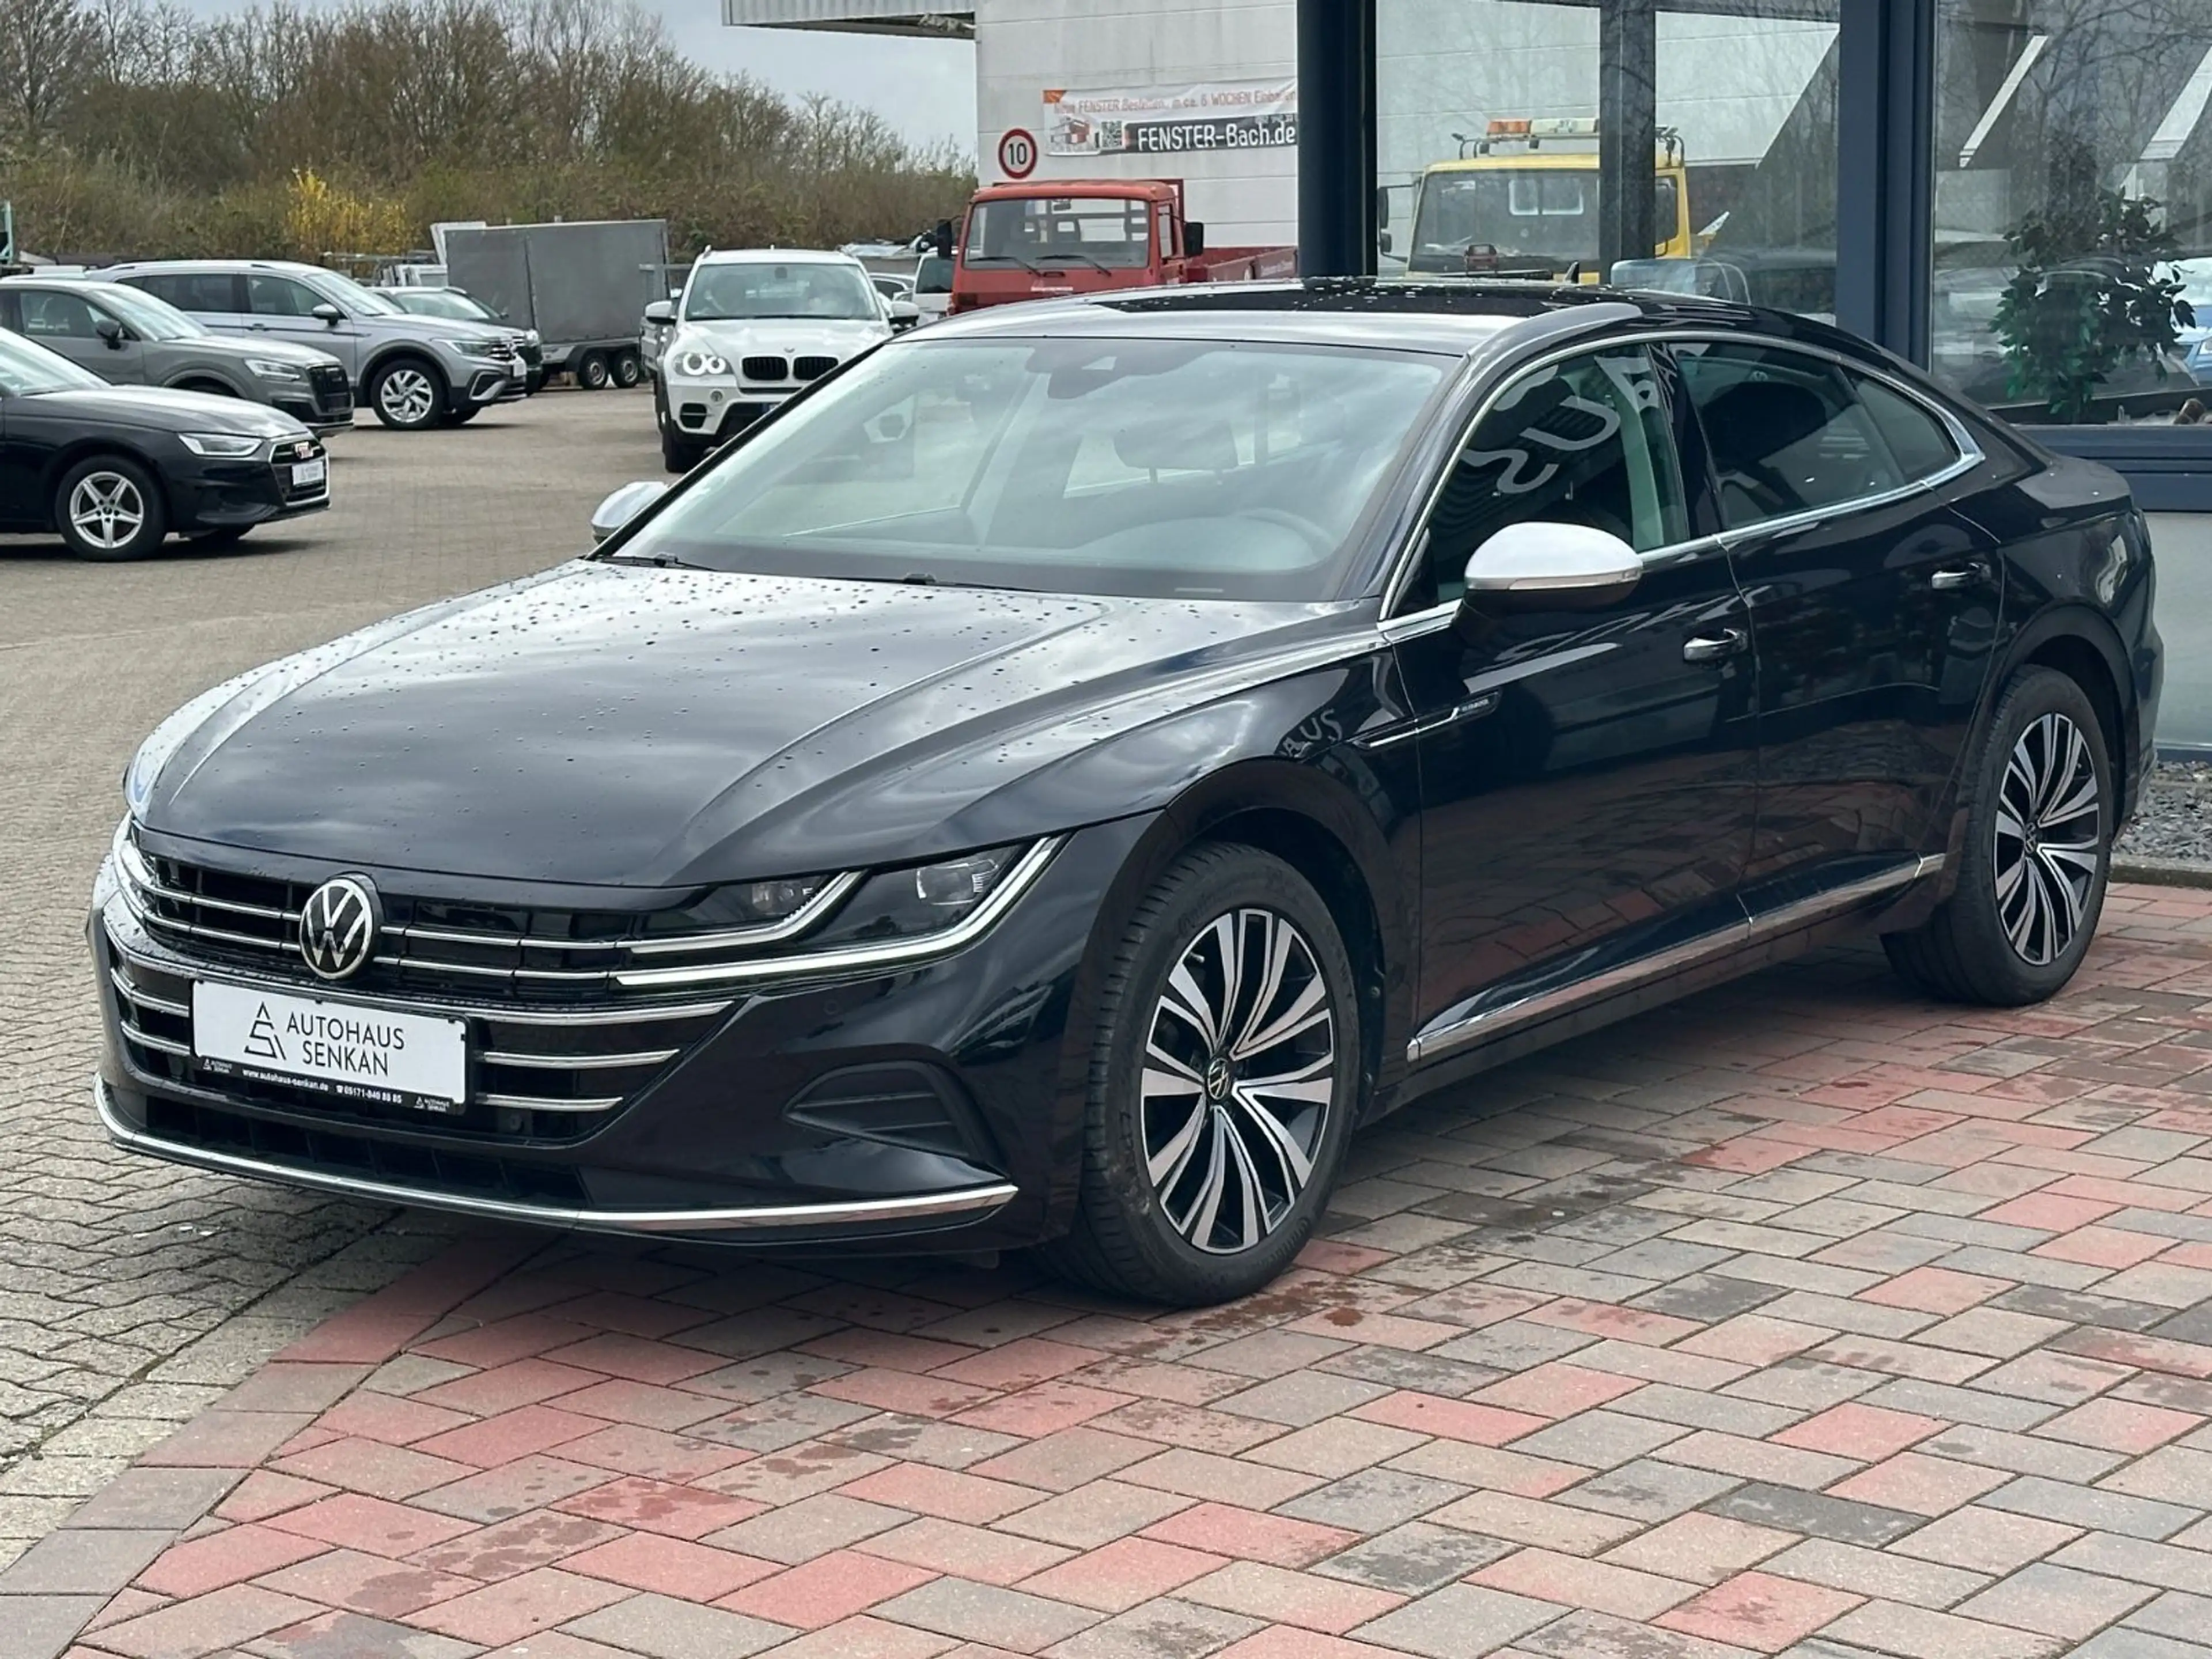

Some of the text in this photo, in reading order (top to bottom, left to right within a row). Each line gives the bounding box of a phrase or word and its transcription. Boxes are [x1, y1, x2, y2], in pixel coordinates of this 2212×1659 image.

[1078, 99, 1120, 113] FENSTER
[1138, 120, 1296, 151] FENSTER-Bach.de
[1008, 142, 1027, 165] 10
[286, 1011, 405, 1051] AUTOHAUS
[302, 1040, 389, 1077] SENKAN
